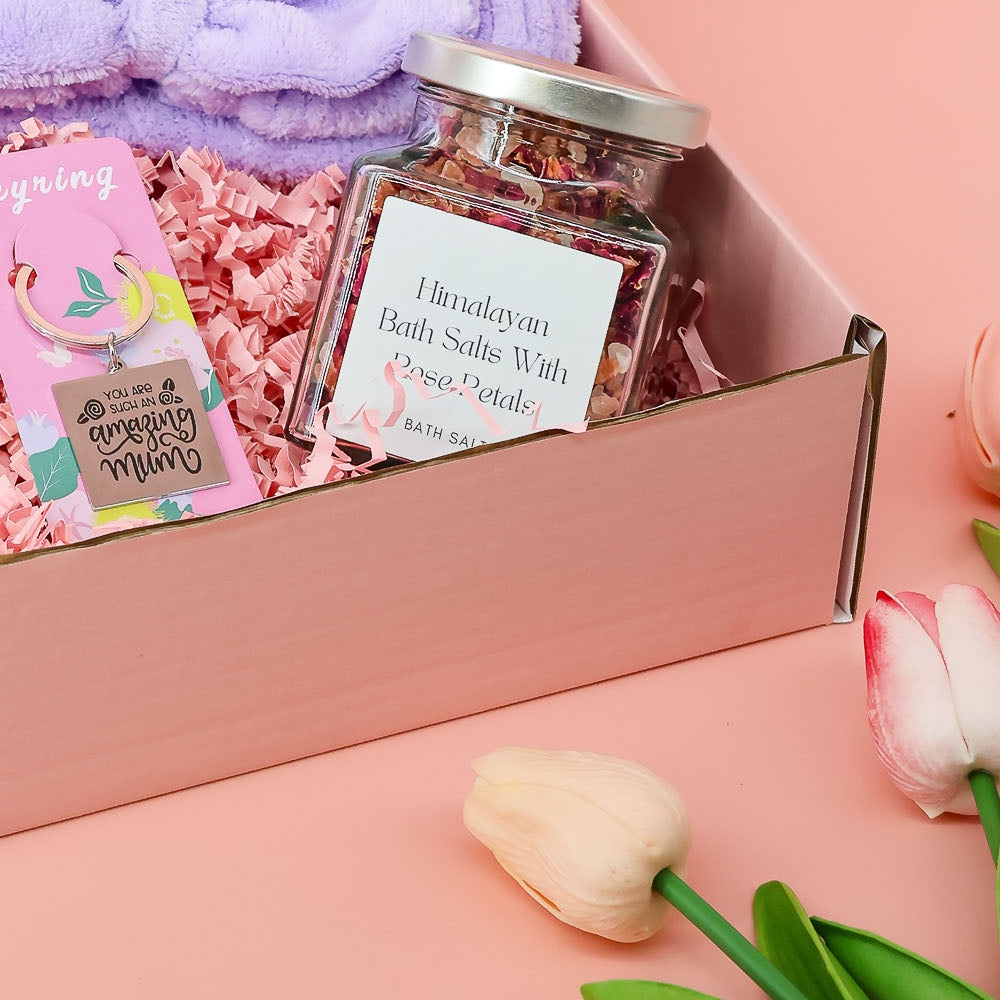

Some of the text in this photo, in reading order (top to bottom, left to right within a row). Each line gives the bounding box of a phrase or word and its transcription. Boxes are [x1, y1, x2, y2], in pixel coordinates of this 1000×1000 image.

[415, 276, 550, 338] Himalayan
[377, 306, 569, 385] Bath Salts With
[103, 387, 129, 401] YOU
[109, 396, 157, 415] SUCH AN
[88, 407, 197, 456] amazing
[404, 418, 443, 440] BATH
[99, 445, 202, 484] mum
